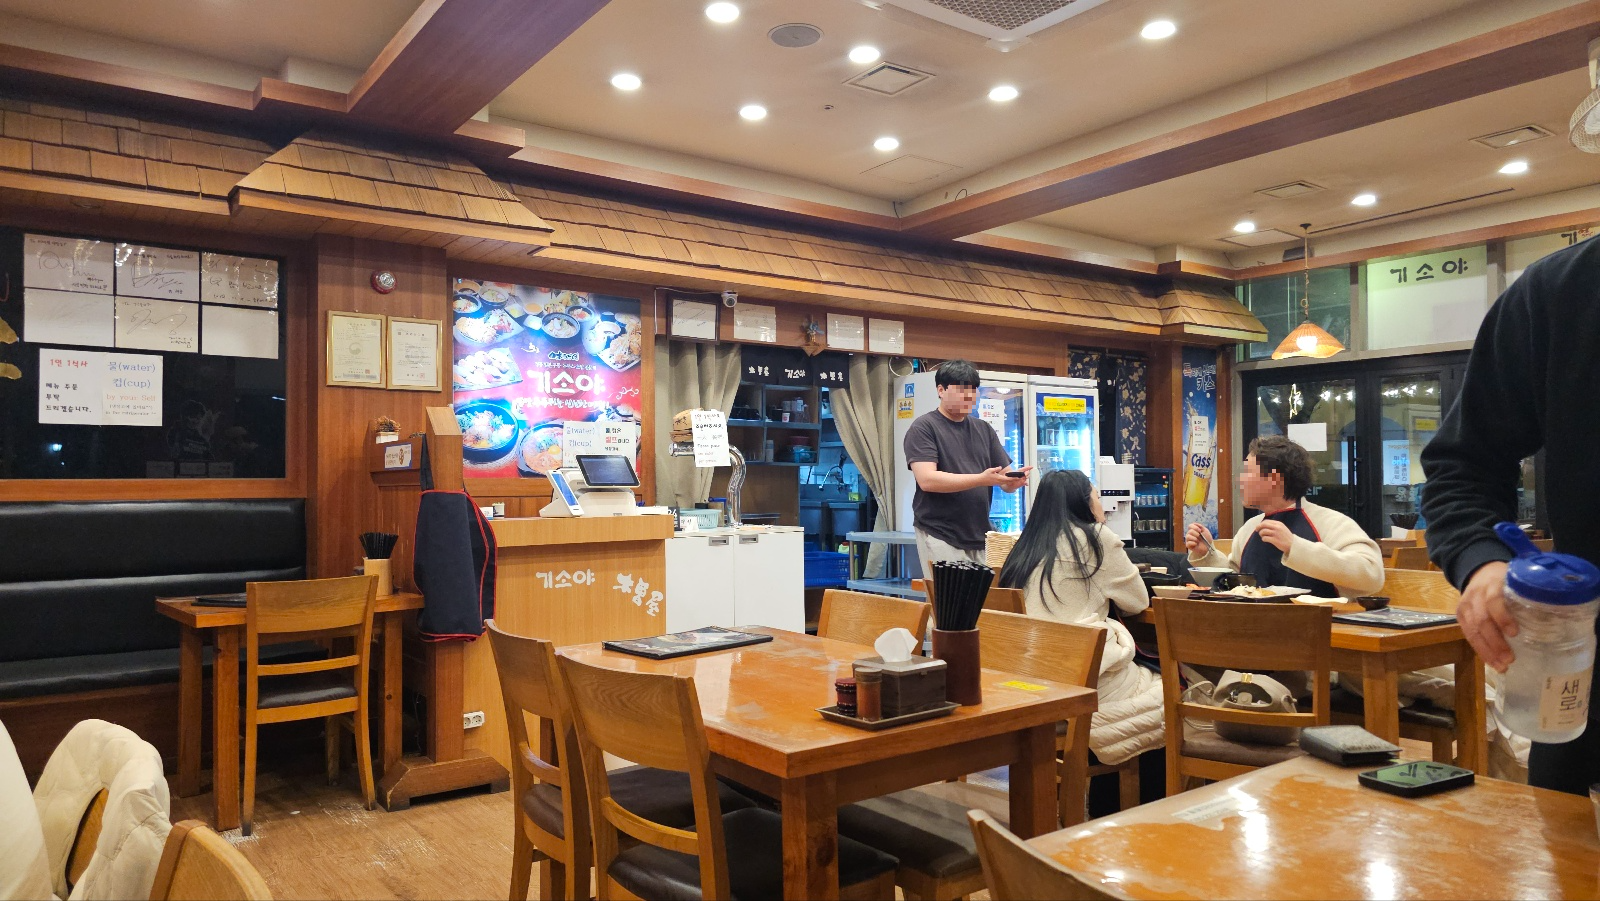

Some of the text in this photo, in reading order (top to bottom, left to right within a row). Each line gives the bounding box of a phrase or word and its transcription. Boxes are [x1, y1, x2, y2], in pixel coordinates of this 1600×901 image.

[1389, 257, 1469, 284] 기소야
[50, 359, 88, 369] 1인 1식사
[108, 361, 156, 373] 물(water)
[46, 382, 60, 390] 메뉴
[526, 369, 606, 396] 기소야
[1191, 453, 1212, 469] Cass
[535, 568, 596, 589] 기소야
